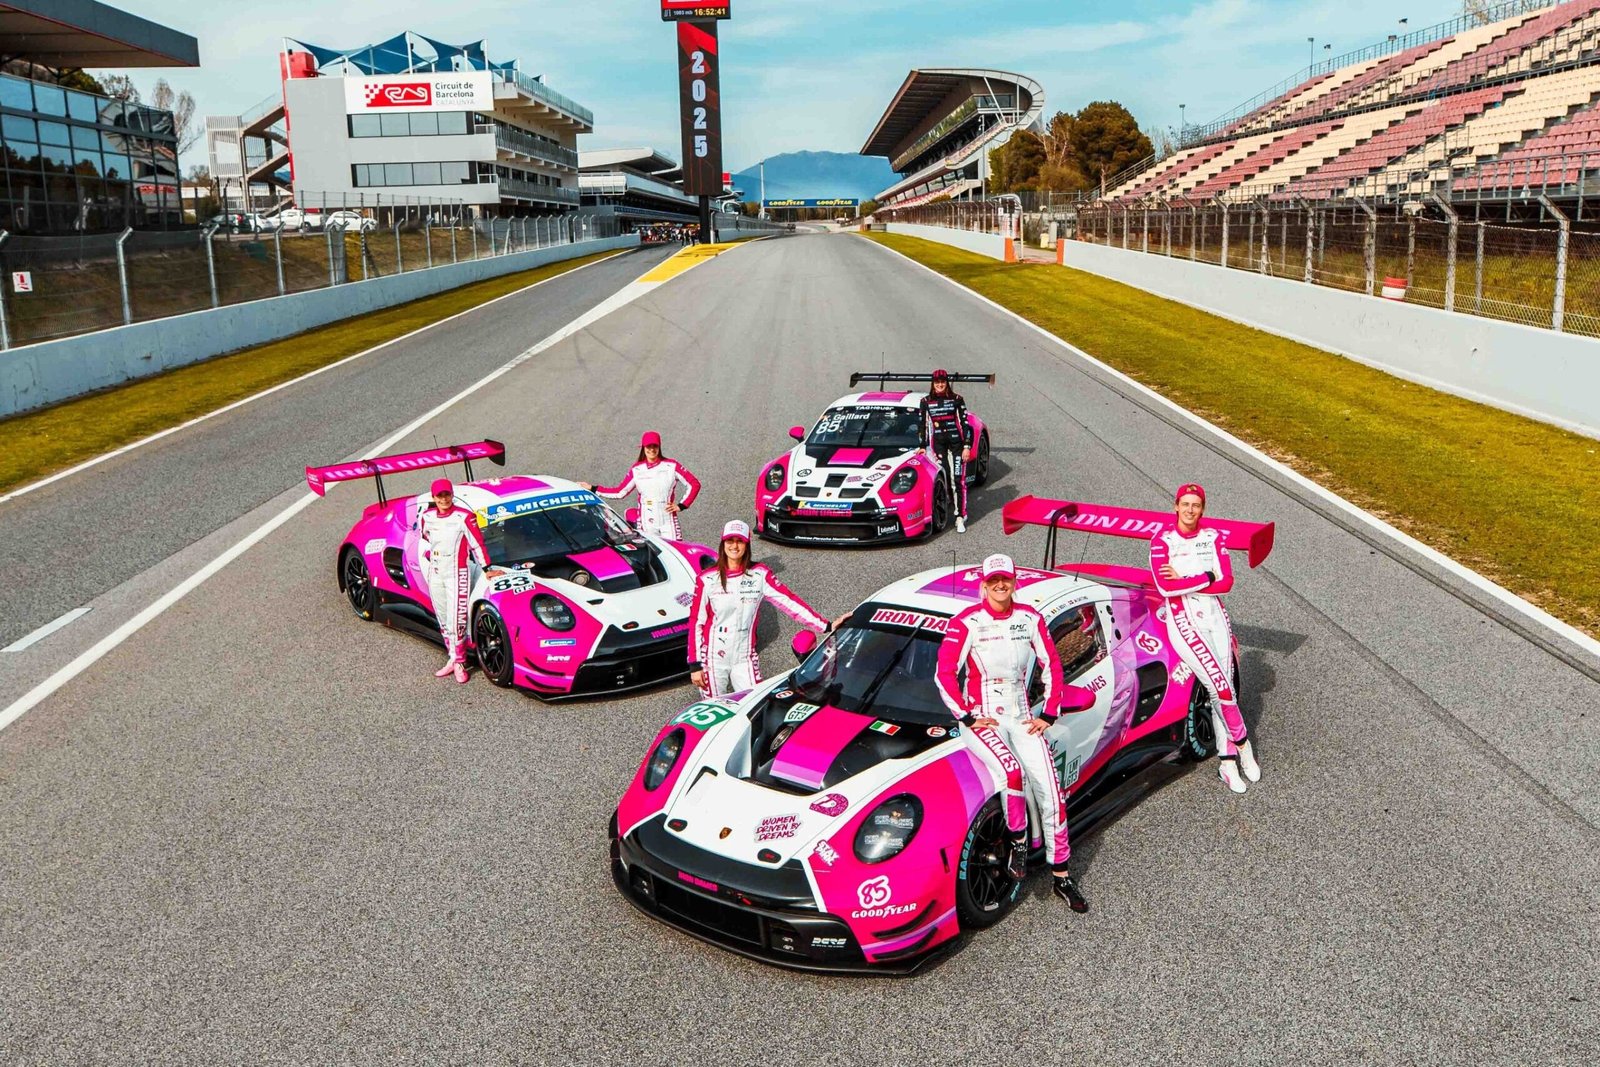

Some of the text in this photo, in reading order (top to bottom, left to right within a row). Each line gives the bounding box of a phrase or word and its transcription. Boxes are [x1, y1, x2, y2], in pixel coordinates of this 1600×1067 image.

[694, 8, 726, 16] 16:52:41
[435, 82, 462, 90] Circuit
[436, 90, 474, 98] Barcelona
[691, 50, 708, 157] 2025
[816, 420, 841, 434] 85
[516, 494, 596, 512] MICHELIN
[458, 568, 468, 596] IRON
[494, 576, 530, 591] 83
[514, 584, 535, 594] GT3
[458, 599, 468, 636] DAMES
[870, 608, 920, 628] IRON
[1174, 610, 1199, 645] IRON
[1192, 643, 1229, 692] DAMES
[675, 704, 729, 726] 85
[787, 710, 807, 720] GT3
[798, 704, 814, 713] LM
[980, 729, 1019, 773] DAMES
[1068, 759, 1079, 774] LM
[1066, 772, 1078, 787] GT3
[756, 821, 802, 834] DRIVEN BY
[762, 816, 796, 826] WOMEN
[758, 831, 795, 842] DREAMS
[859, 876, 890, 907] 85
[852, 902, 917, 918] GOODYEAR
